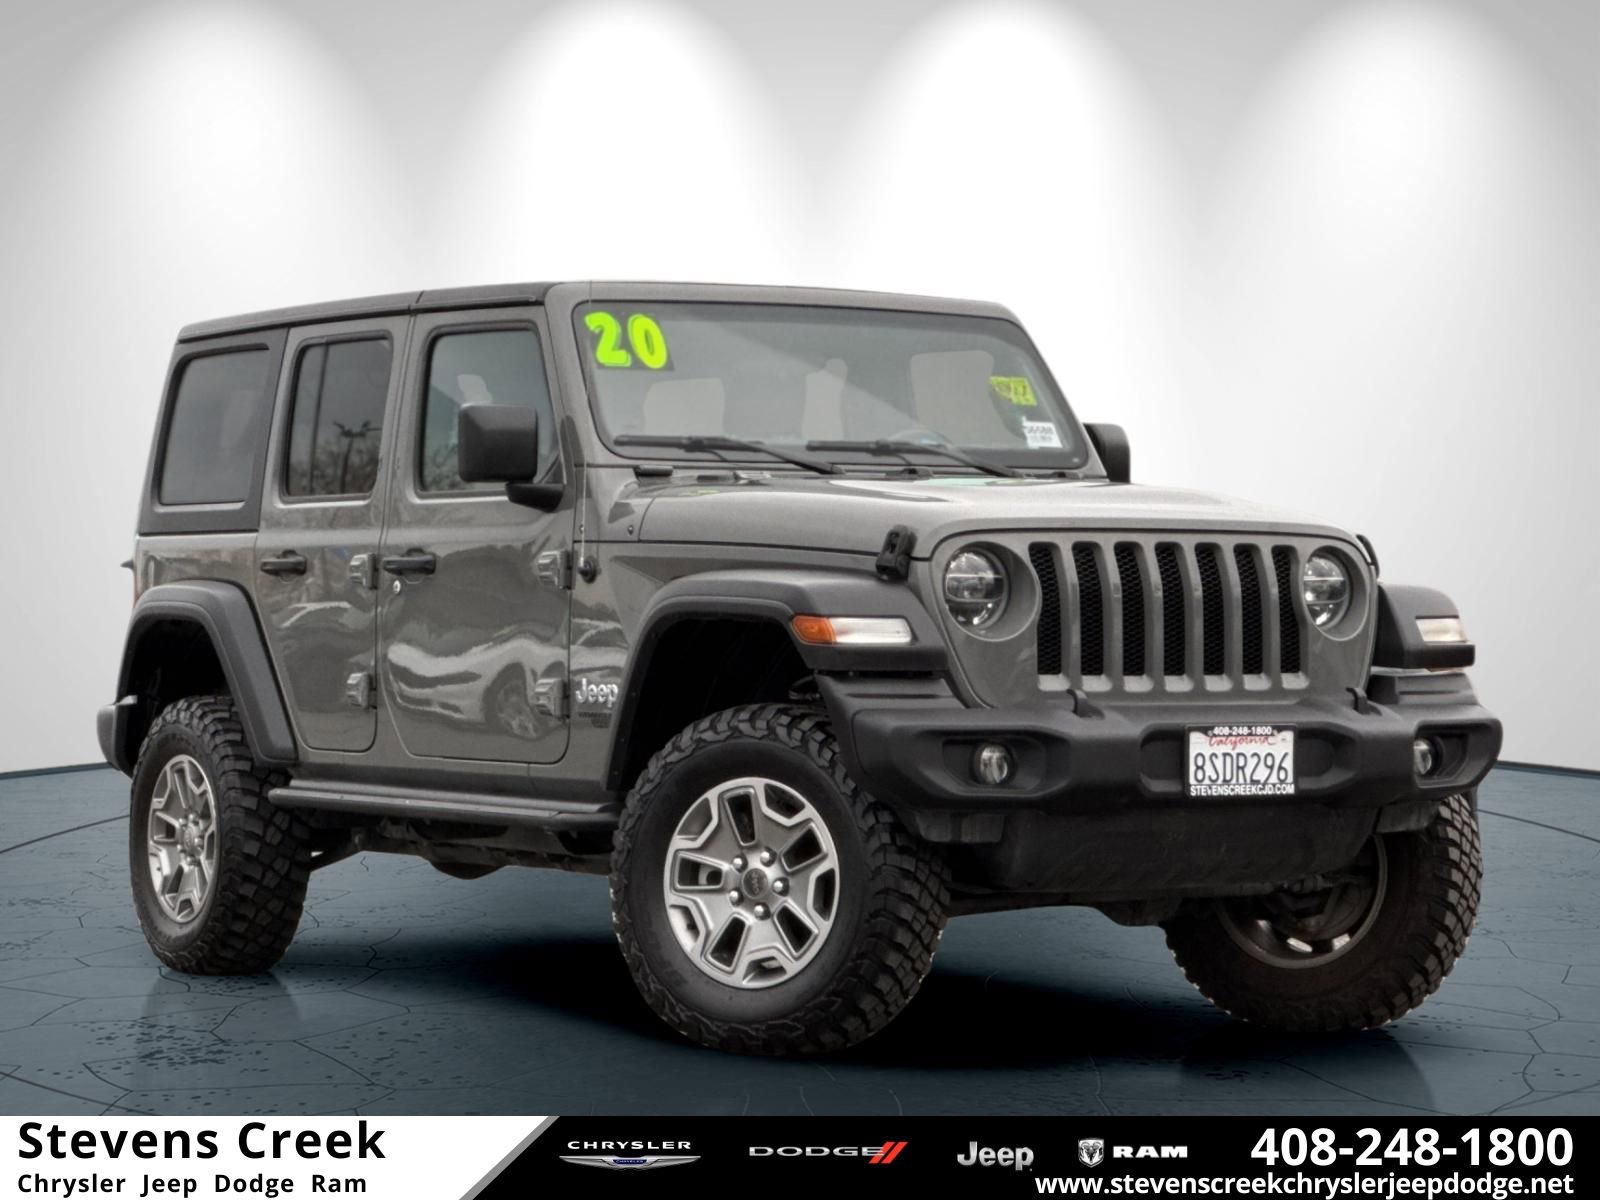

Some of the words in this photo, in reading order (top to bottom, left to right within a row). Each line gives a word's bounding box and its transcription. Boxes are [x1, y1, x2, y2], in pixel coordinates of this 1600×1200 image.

[584, 311, 667, 369] 20
[575, 677, 618, 708] Jeep
[1213, 726, 1272, 736] 408-248-1800
[1193, 752, 1289, 784] 8SDR296
[1190, 784, 1296, 797] STEVENSCREEKCJD.COM
